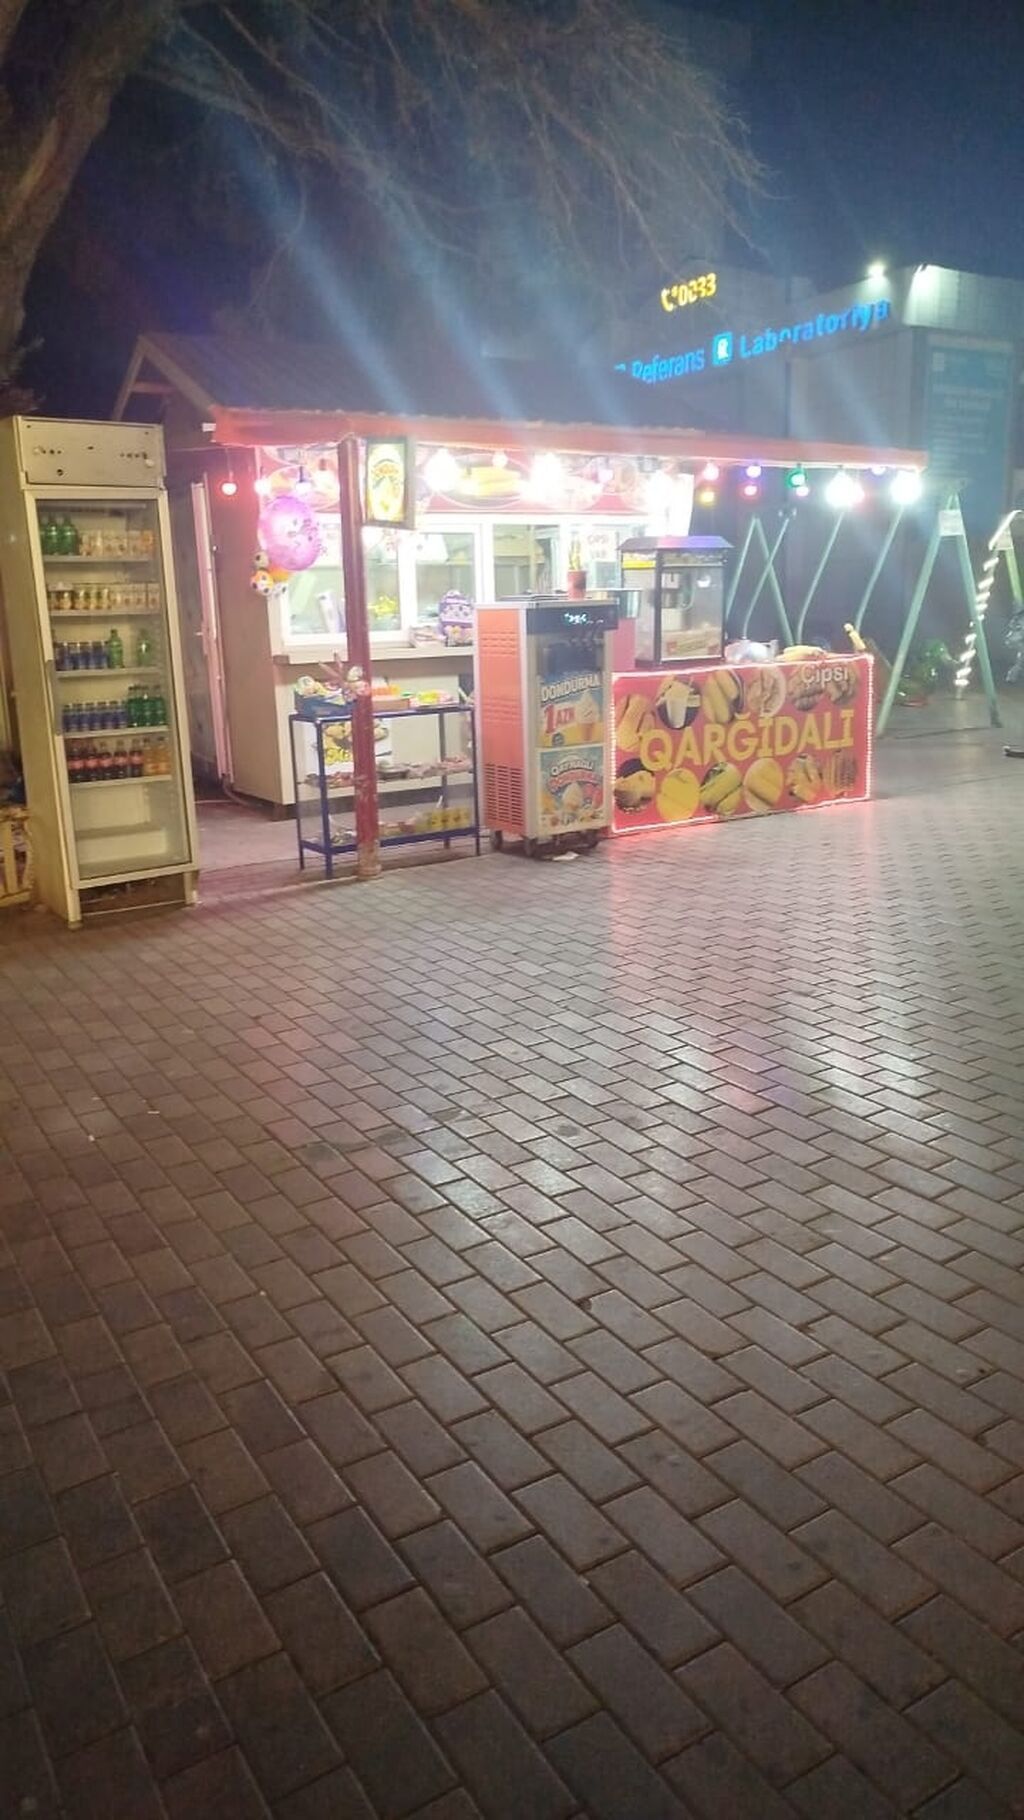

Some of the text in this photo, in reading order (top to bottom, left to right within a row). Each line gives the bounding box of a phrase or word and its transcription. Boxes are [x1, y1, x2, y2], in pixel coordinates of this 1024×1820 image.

[739, 298, 891, 359] Laboratoriya
[541, 673, 601, 702] DONDURMA
[544, 703, 555, 733] 1
